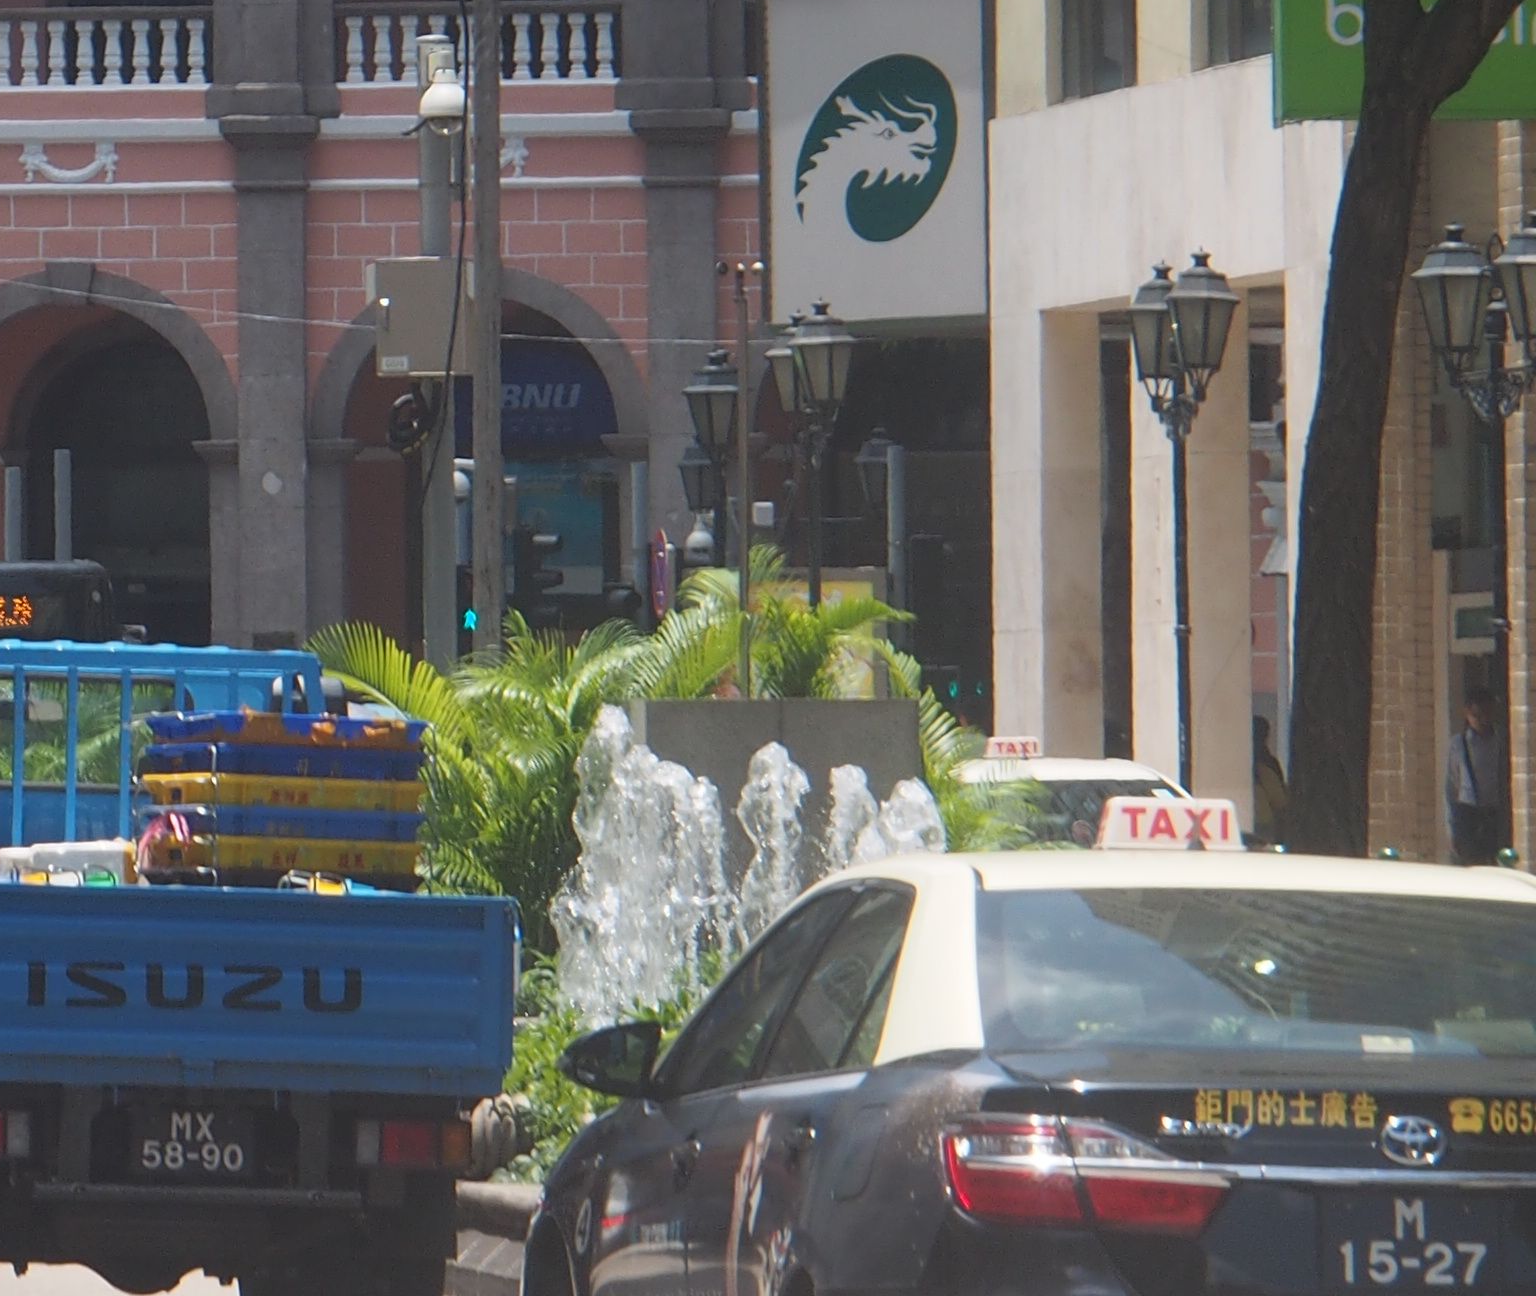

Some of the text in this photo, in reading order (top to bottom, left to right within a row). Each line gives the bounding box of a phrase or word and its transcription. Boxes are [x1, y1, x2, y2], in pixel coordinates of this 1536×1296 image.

[502, 383, 582, 409] BNU
[994, 741, 1040, 756] TAXI
[1121, 805, 1230, 842] TAXI
[27, 960, 363, 1013] ISUZU
[170, 1111, 215, 1142] MX
[1488, 1098, 1536, 1135] 665
[141, 1140, 244, 1172] 58-90
[1393, 1198, 1426, 1241] M
[1339, 1240, 1488, 1286] 15-27
